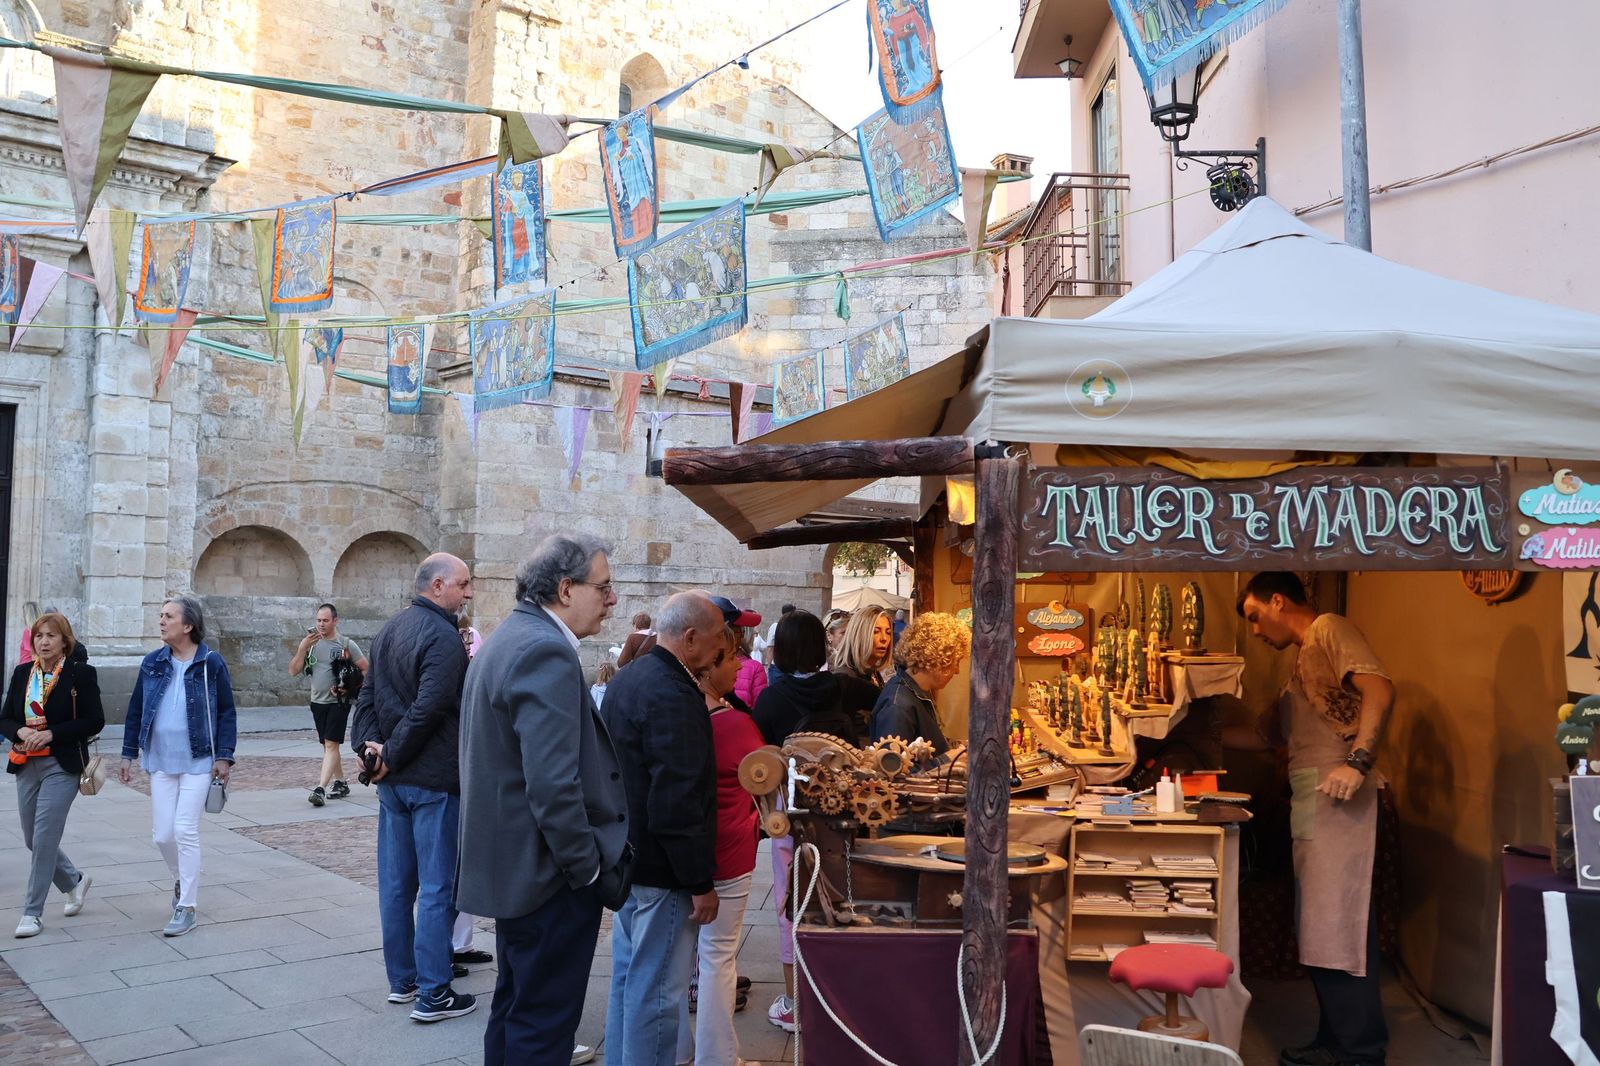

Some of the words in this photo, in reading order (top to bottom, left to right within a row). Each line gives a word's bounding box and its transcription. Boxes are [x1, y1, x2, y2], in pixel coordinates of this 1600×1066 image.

[1041, 484, 1226, 555] TALLER
[1271, 485, 1502, 554] MADERA
[1033, 611, 1077, 626] Alejandro
